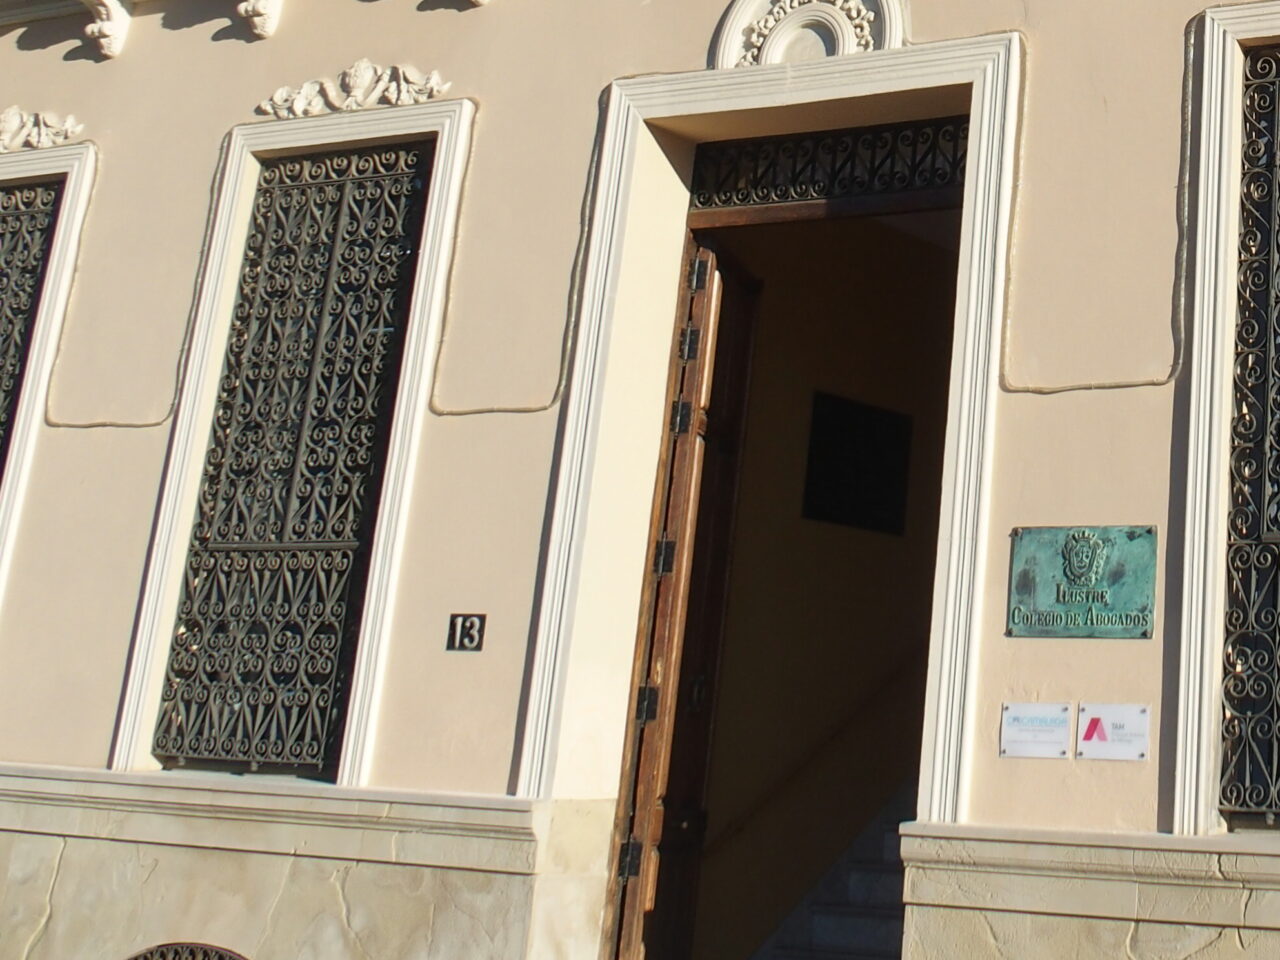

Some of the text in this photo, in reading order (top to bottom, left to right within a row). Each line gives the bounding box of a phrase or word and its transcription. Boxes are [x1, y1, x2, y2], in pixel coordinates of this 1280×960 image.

[1055, 582, 1109, 604] ILUSTRE
[1011, 605, 1150, 627] COLEGIO DE ABOGADOS
[454, 616, 481, 649] 13
